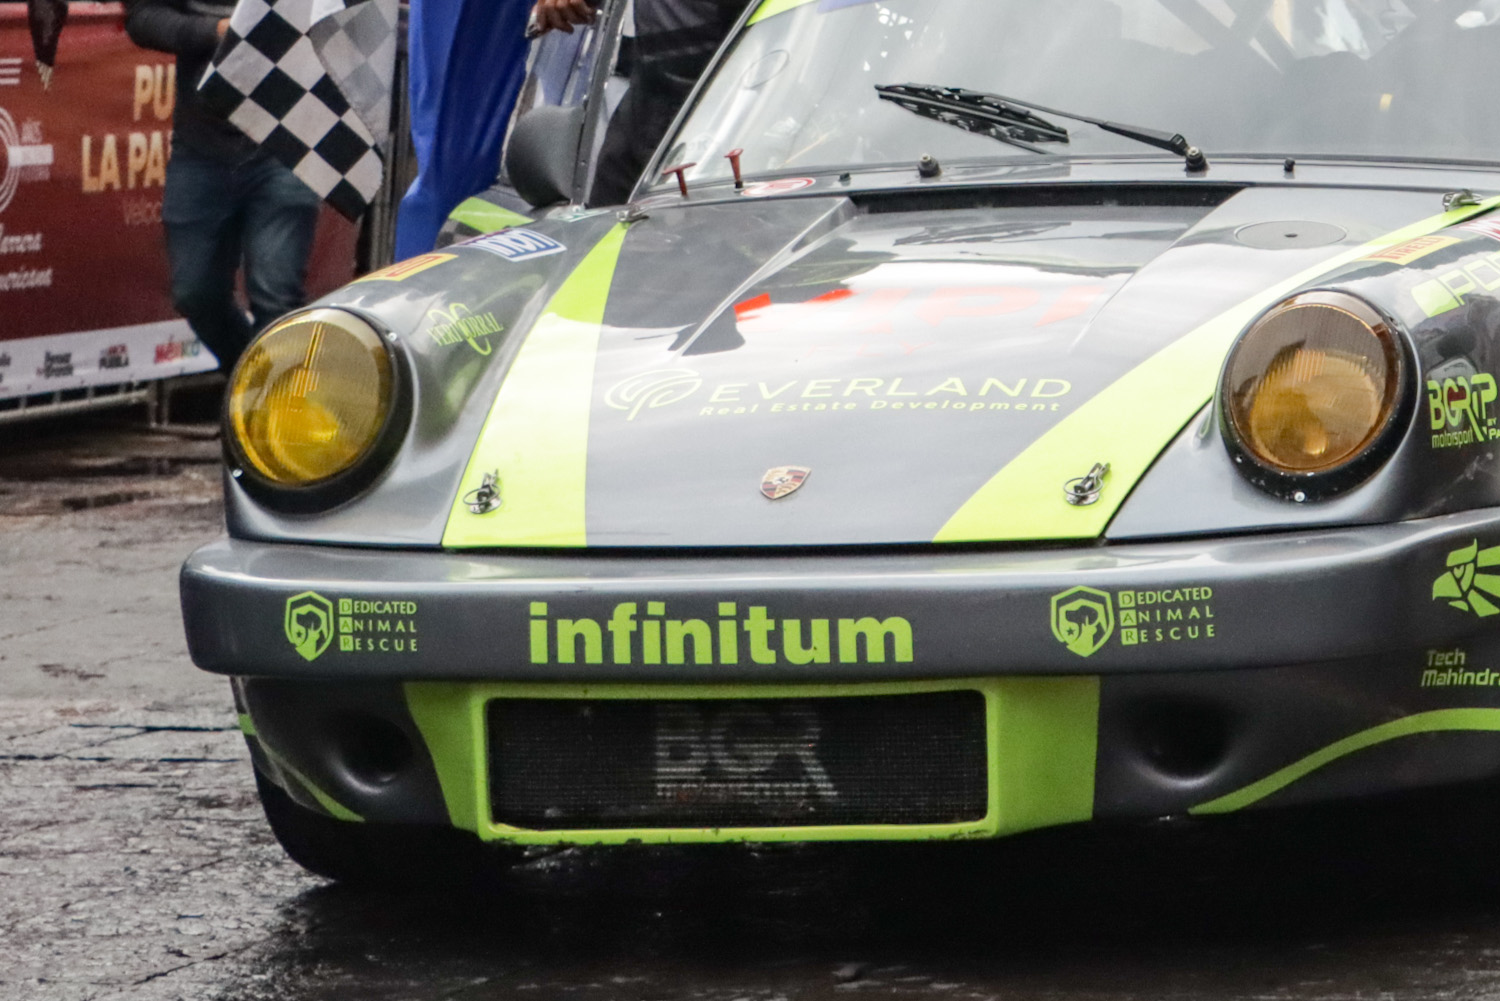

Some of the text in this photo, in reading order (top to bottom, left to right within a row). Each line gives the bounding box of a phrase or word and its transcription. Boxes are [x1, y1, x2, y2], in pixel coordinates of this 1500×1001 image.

[133, 64, 177, 122] PU
[81, 133, 121, 193] LA
[709, 377, 1073, 402] EVERLAND
[699, 398, 1061, 416] Real Estate Development
[1431, 426, 1474, 449] motorsport
[339, 598, 417, 615] DEDICATED
[1118, 586, 1213, 608] DEDICATED
[339, 616, 418, 633] ANIMAL
[1119, 605, 1214, 627] ANIMAL
[339, 634, 418, 651] RESCUE
[529, 600, 914, 665] infinitum
[1121, 624, 1216, 646] RESCUE
[1426, 649, 1466, 666] Tech
